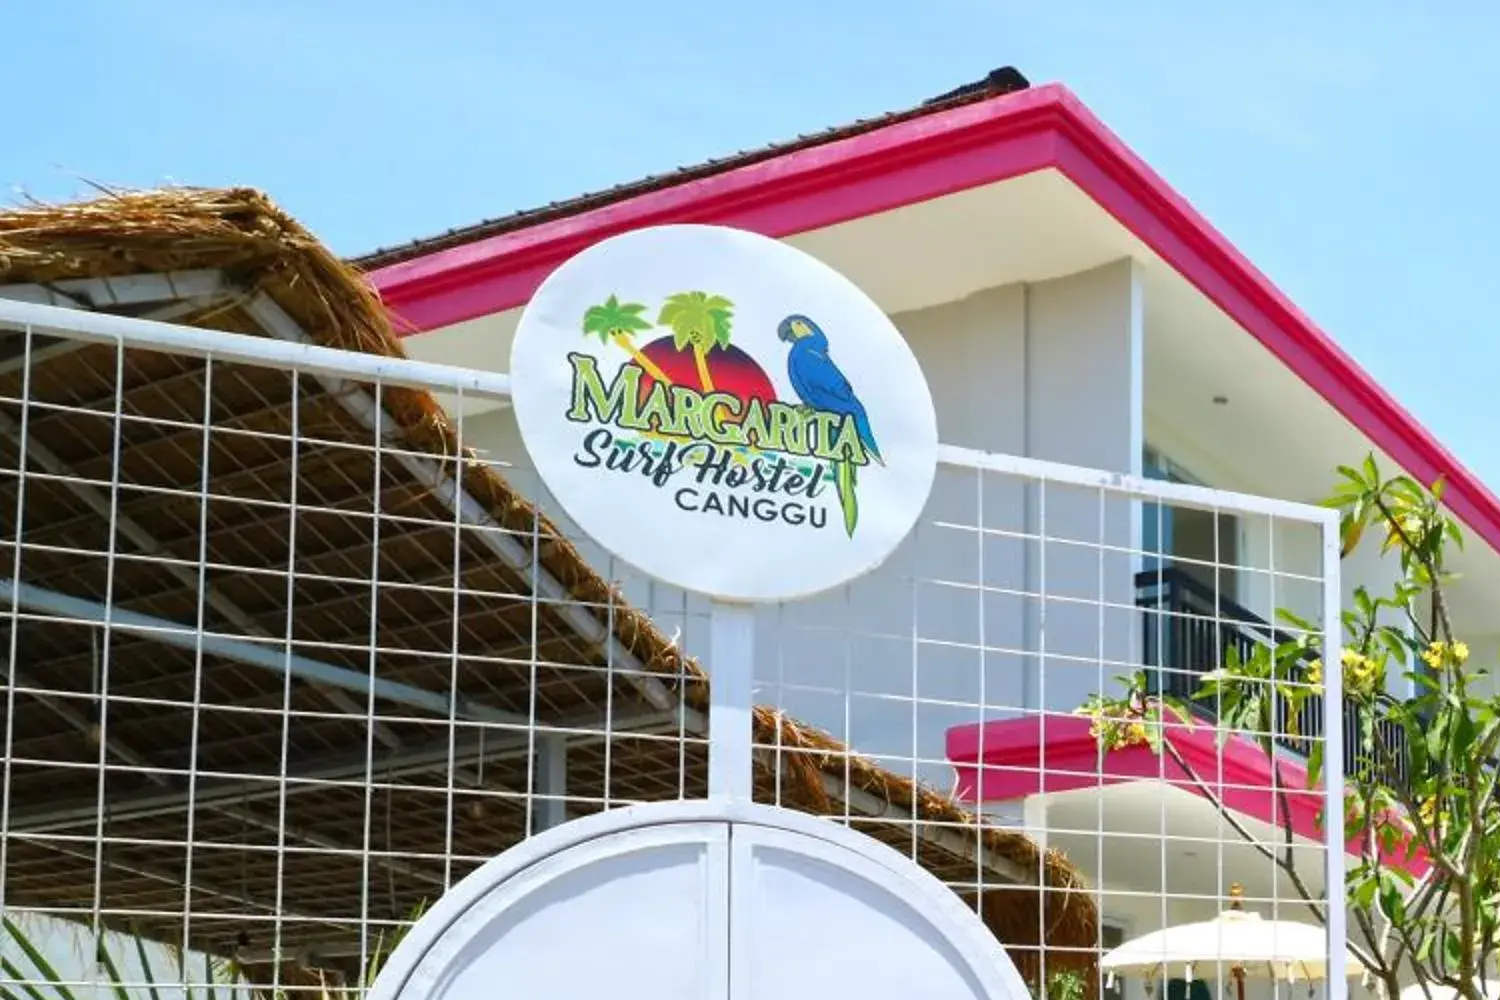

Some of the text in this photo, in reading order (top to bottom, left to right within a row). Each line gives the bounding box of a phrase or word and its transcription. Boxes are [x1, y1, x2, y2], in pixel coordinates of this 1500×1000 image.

[566, 352, 870, 467] MARGARITA
[573, 430, 827, 499] Surf Hostel
[674, 488, 828, 529] CANGGU
